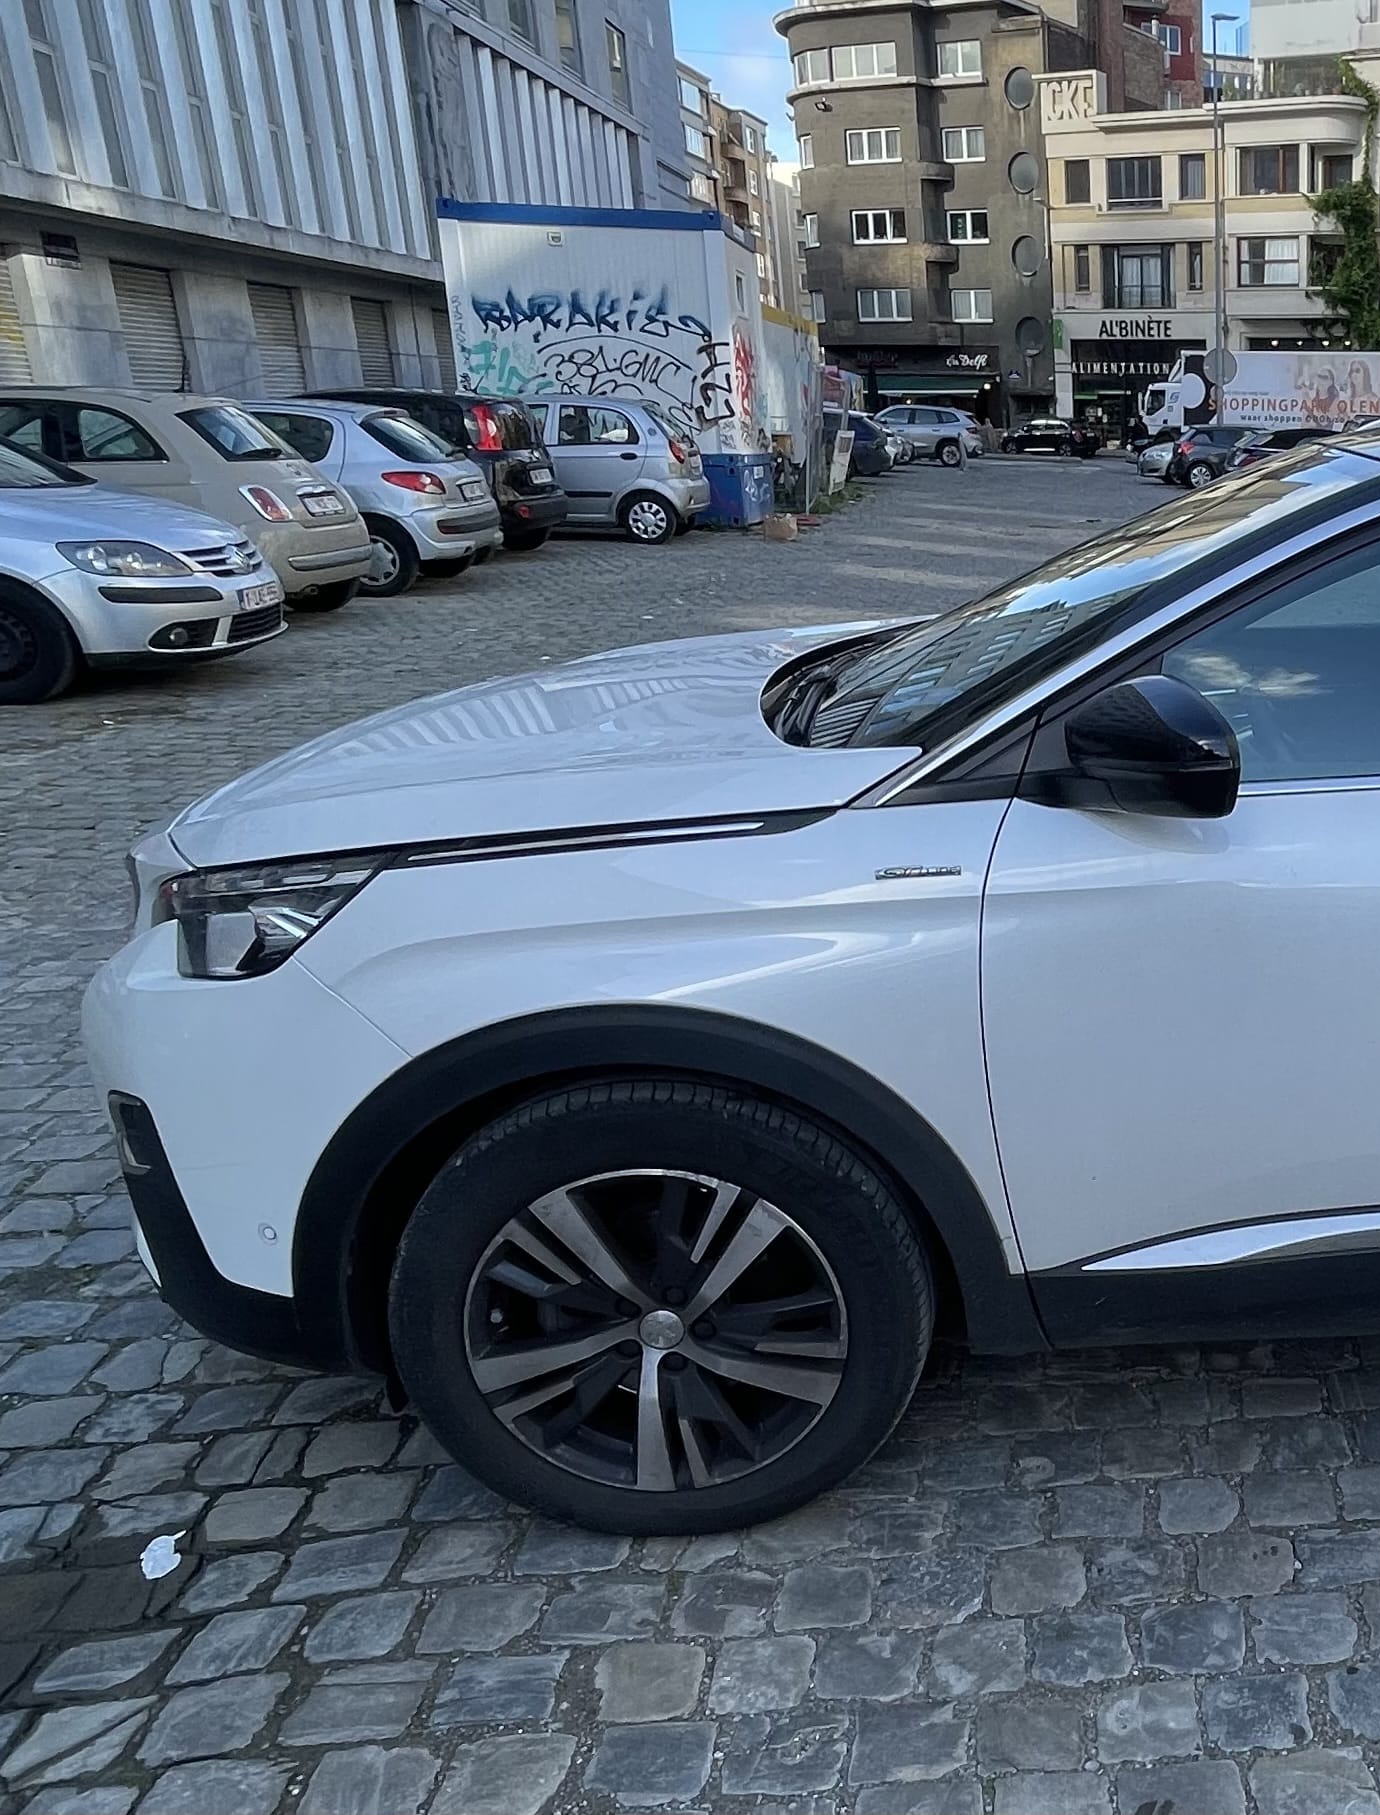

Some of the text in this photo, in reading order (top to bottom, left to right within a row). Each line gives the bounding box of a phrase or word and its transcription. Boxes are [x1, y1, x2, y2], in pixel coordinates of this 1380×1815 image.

[1099, 314, 1172, 338] AL'BINÈTE
[1071, 361, 1171, 376] ALIMENTATION
[1336, 399, 1380, 414] OLEN
